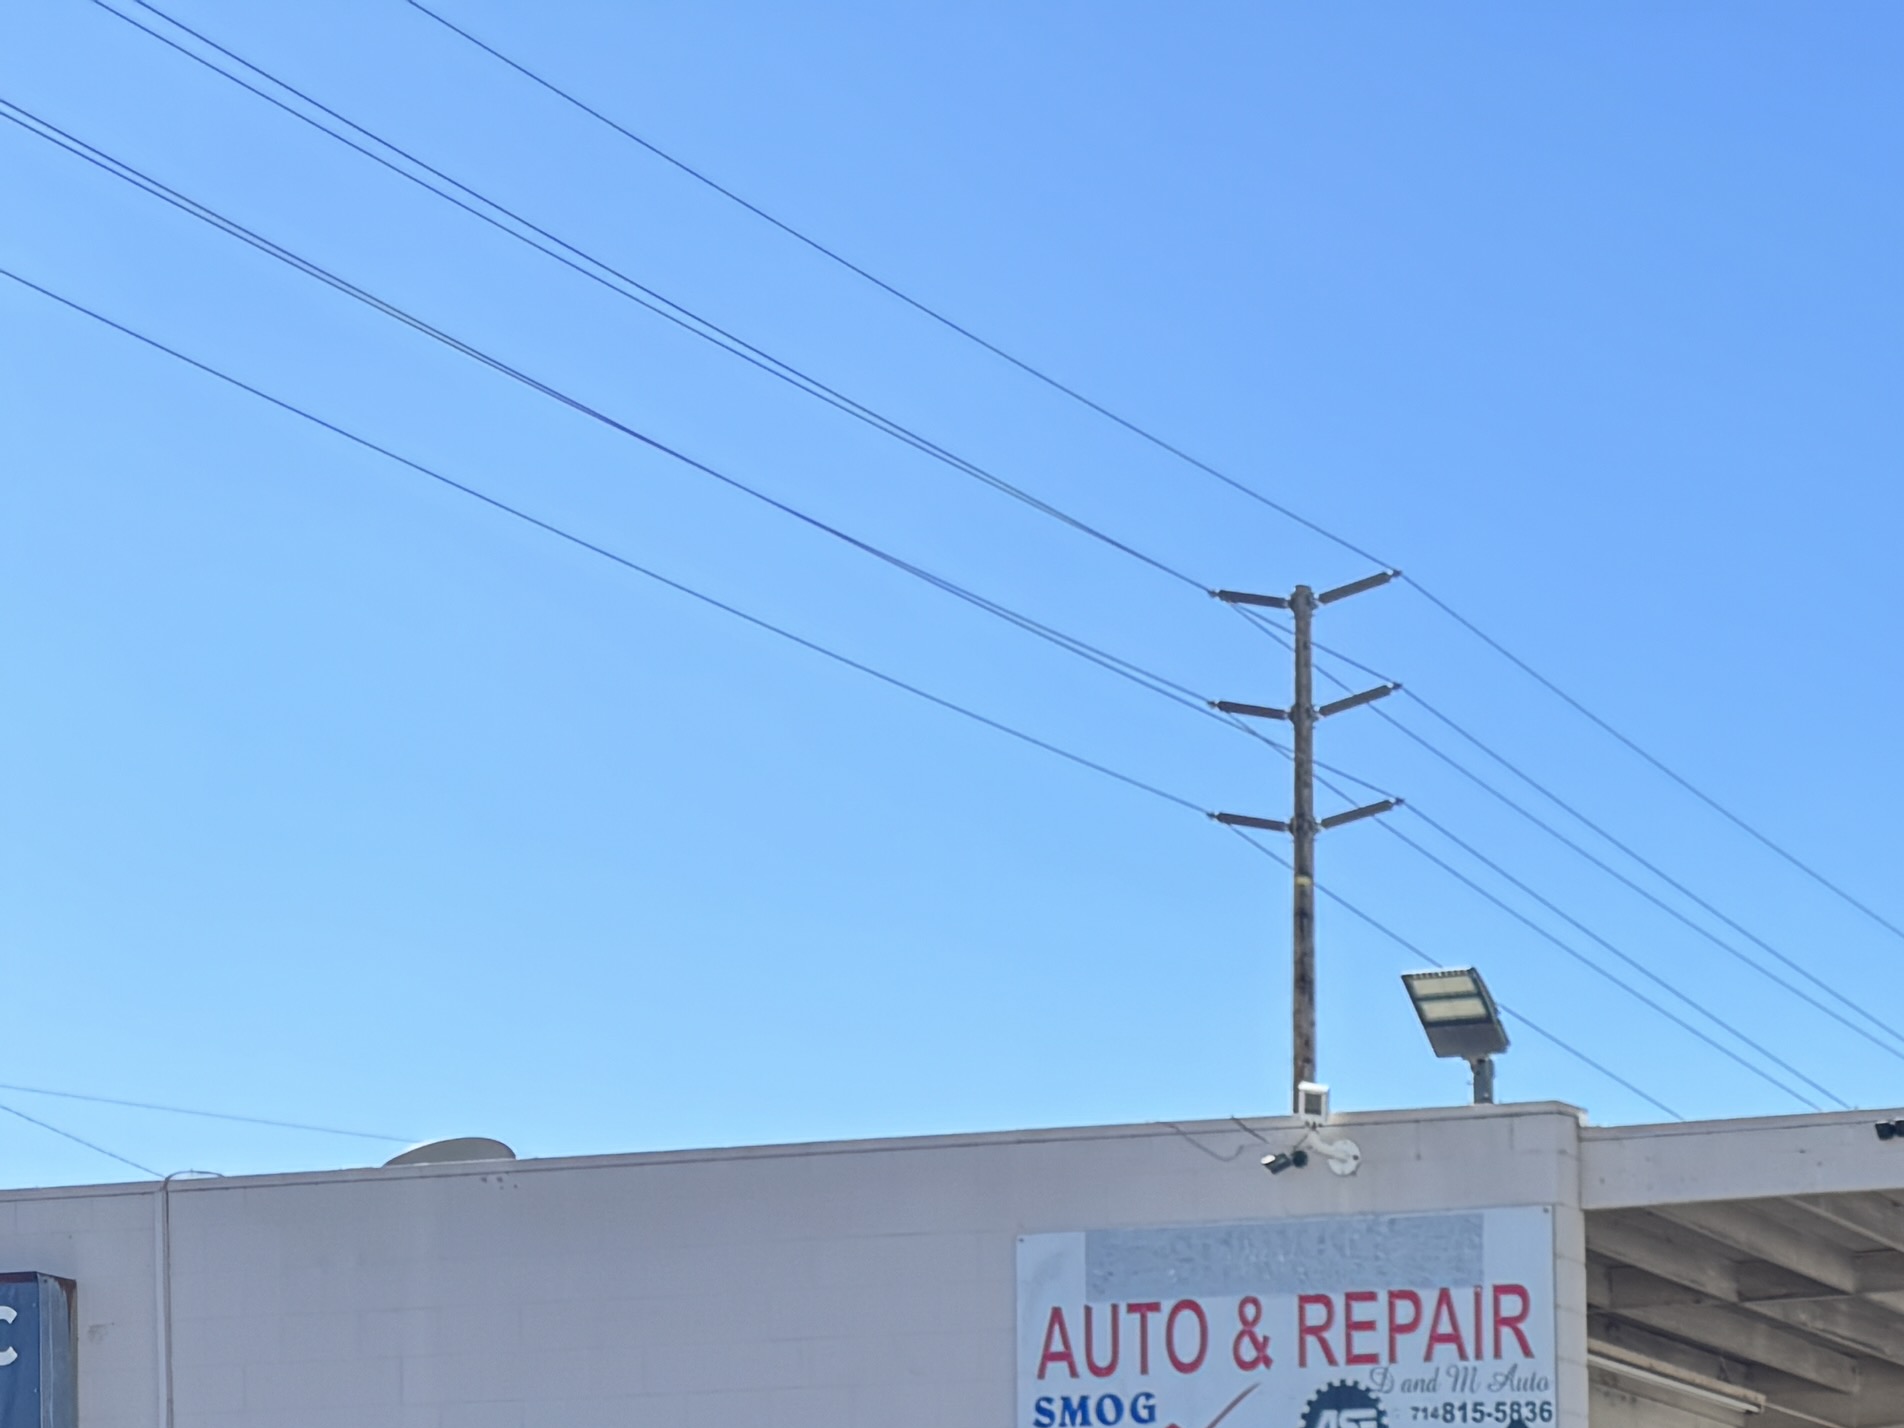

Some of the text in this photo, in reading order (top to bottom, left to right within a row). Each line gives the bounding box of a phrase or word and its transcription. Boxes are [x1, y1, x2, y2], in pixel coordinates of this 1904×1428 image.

[1037, 1284, 1536, 1380] AUTO & REPAIR
[1401, 1366, 1440, 1394] and
[1446, 1365, 1480, 1394] M
[1487, 1363, 1551, 1394] Auto
[1033, 1392, 1157, 1428] SMOG
